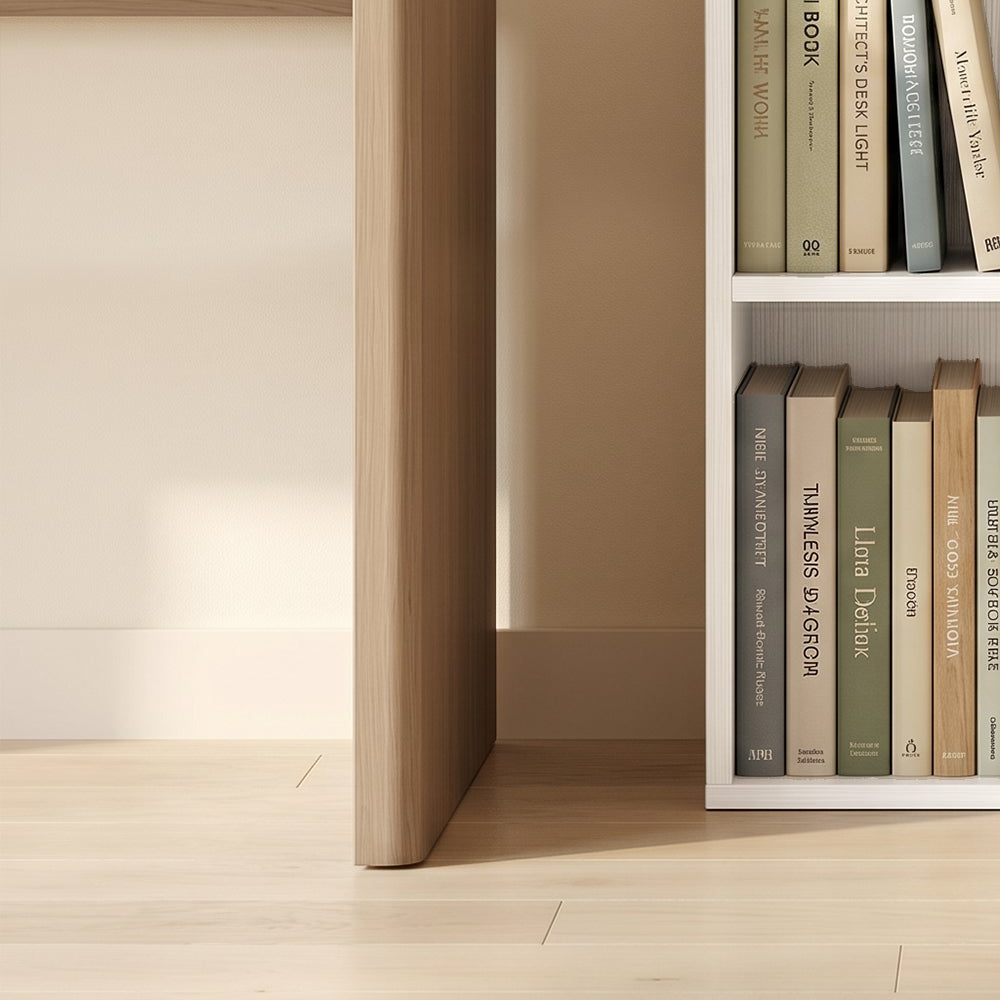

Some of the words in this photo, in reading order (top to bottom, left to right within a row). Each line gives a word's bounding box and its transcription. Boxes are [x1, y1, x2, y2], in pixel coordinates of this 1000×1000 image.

[804, 11, 819, 67] BOOK
[854, 78, 868, 119] DESK
[854, 124, 868, 172] LIGHT
